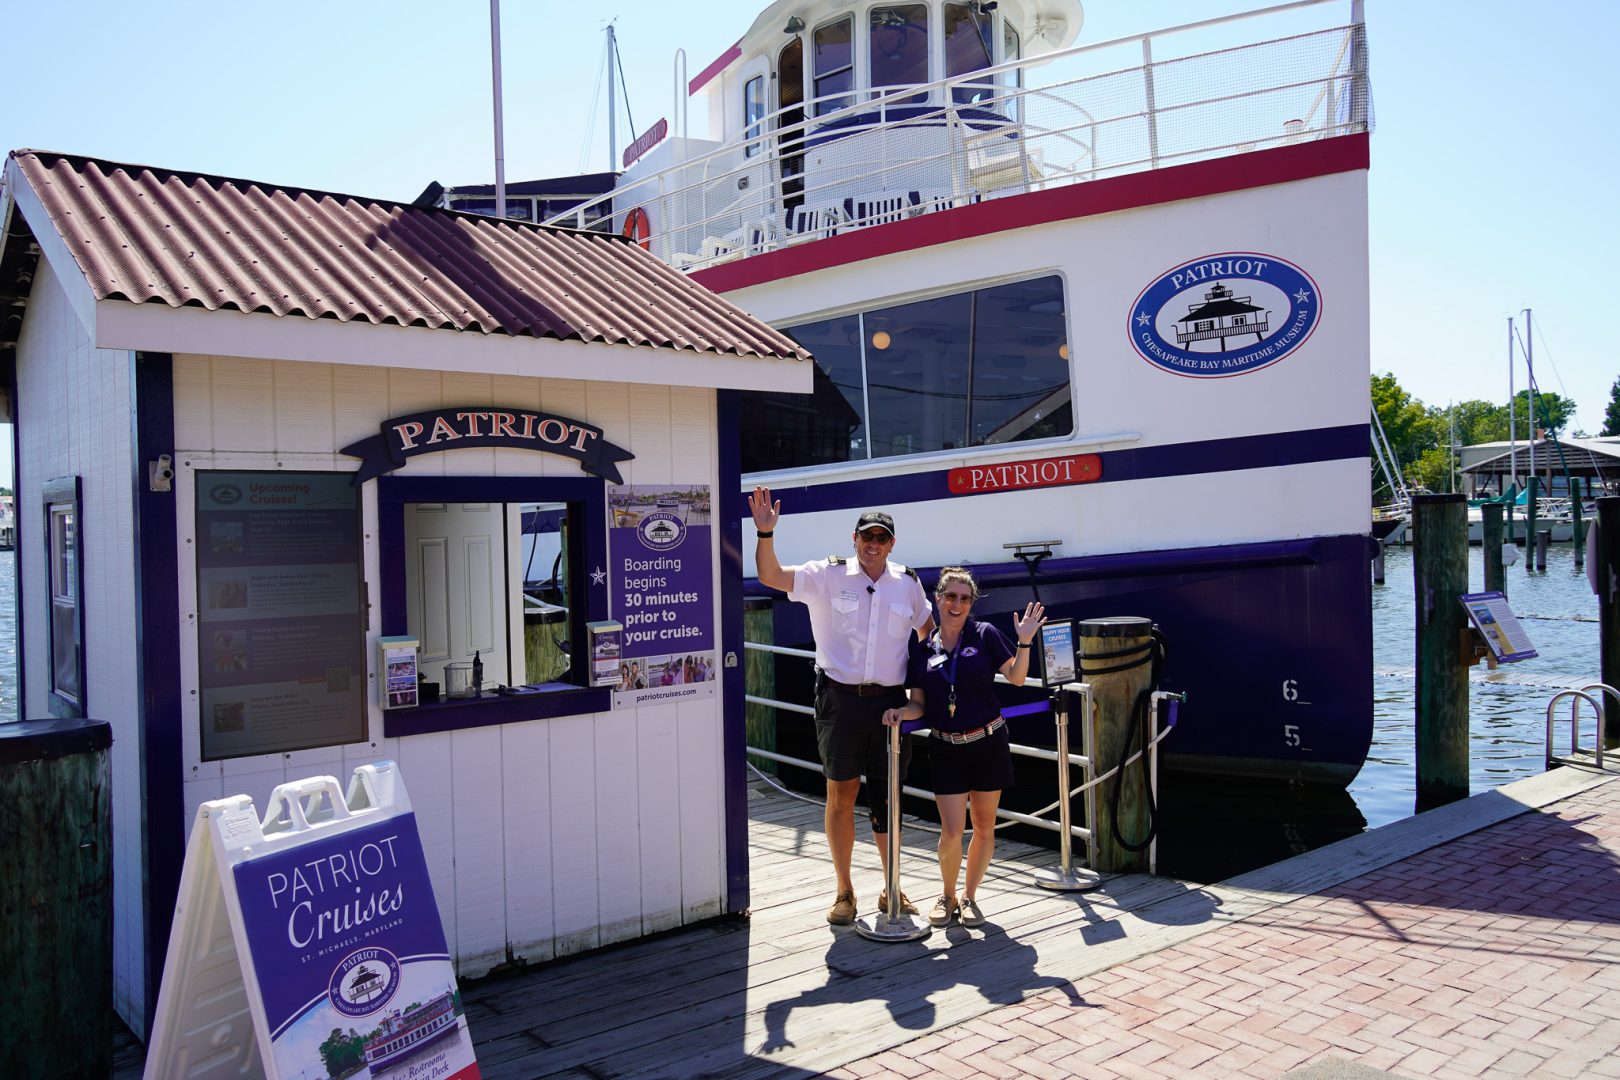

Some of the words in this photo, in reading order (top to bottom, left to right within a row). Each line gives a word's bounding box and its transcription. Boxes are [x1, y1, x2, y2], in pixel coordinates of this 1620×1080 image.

[630, 127, 657, 161] PATRIOT
[1170, 260, 1268, 291] PATRIOT
[1142, 332, 1198, 369] CHESAPEAKE
[1200, 360, 1220, 369] BAY
[1222, 345, 1276, 368] MARITIME
[1275, 310, 1308, 350] MUSEUM
[393, 412, 598, 452] PATRIOT
[970, 459, 1076, 489] PATRIOT
[249, 481, 311, 495] Upcoming
[249, 495, 298, 505] Cruises!
[649, 513, 675, 521] PATRIOT
[625, 557, 682, 572] Boarding
[625, 575, 667, 591] begins
[625, 593, 642, 607] 30
[645, 591, 699, 606] minutes
[626, 611, 659, 628] prior
[662, 610, 677, 622] to
[626, 630, 657, 646] your
[660, 625, 703, 640] cruise.
[636, 689, 697, 703] patriotcruises.com
[1283, 679, 1298, 701] 6
[1285, 724, 1300, 747] 5
[267, 836, 398, 908] PATRIOT
[288, 882, 403, 949] Cruises
[301, 953, 315, 964] ST.
[318, 937, 361, 957] MICHAELS,
[365, 918, 404, 939] MARYLAND
[342, 950, 378, 971] PATRIOT
[408, 1052, 447, 1079] Restrooms
[431, 1061, 450, 1079] Deck
